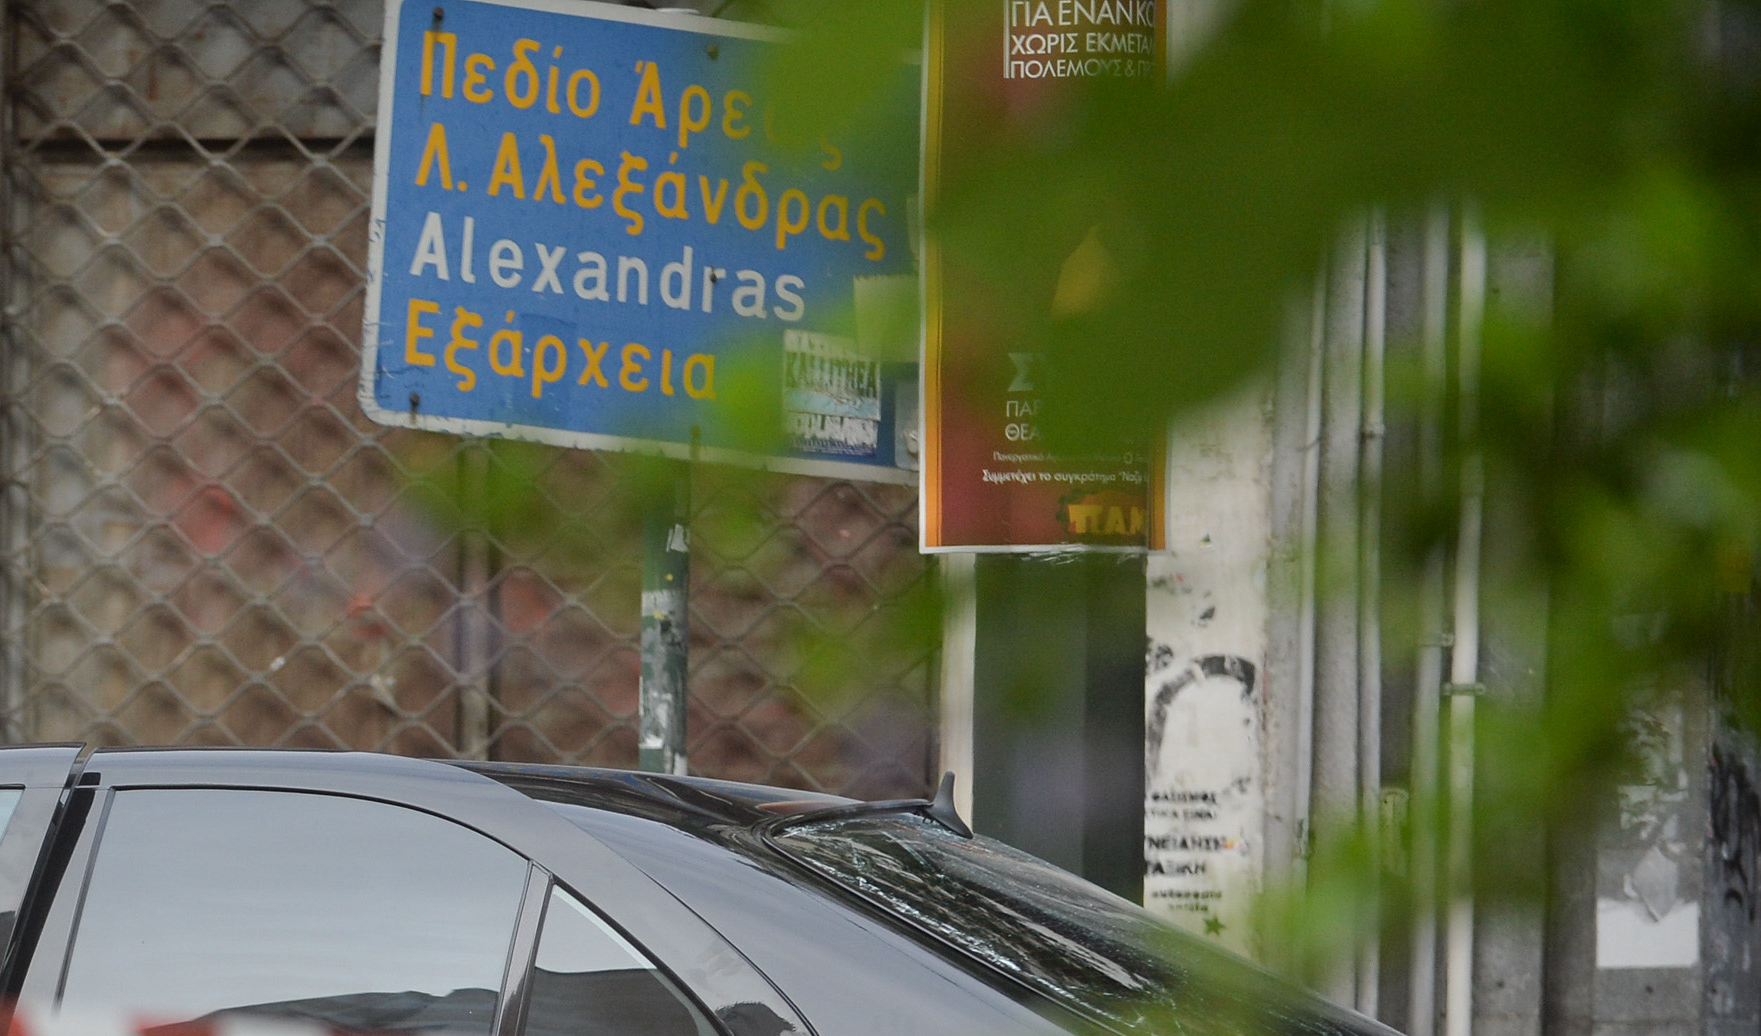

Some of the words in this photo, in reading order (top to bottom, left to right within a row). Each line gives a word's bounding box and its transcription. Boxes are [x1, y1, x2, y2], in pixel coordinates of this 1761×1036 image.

[1010, 33, 1079, 55] ΧΩΡΙΣ
[1011, 0, 1054, 27] ΓΙΑ
[1058, 0, 1133, 26] ΕΝΑΝ
[420, 30, 600, 118] Πεδίο
[629, 60, 843, 171] Άρες
[1010, 58, 1122, 79] ΠΟΛΕΜΟΥΣ
[415, 122, 468, 192] Λ.
[488, 132, 887, 261] Αλεξάνδρας
[410, 211, 806, 321] Alexandras
[404, 298, 717, 399] Εξάρχεια
